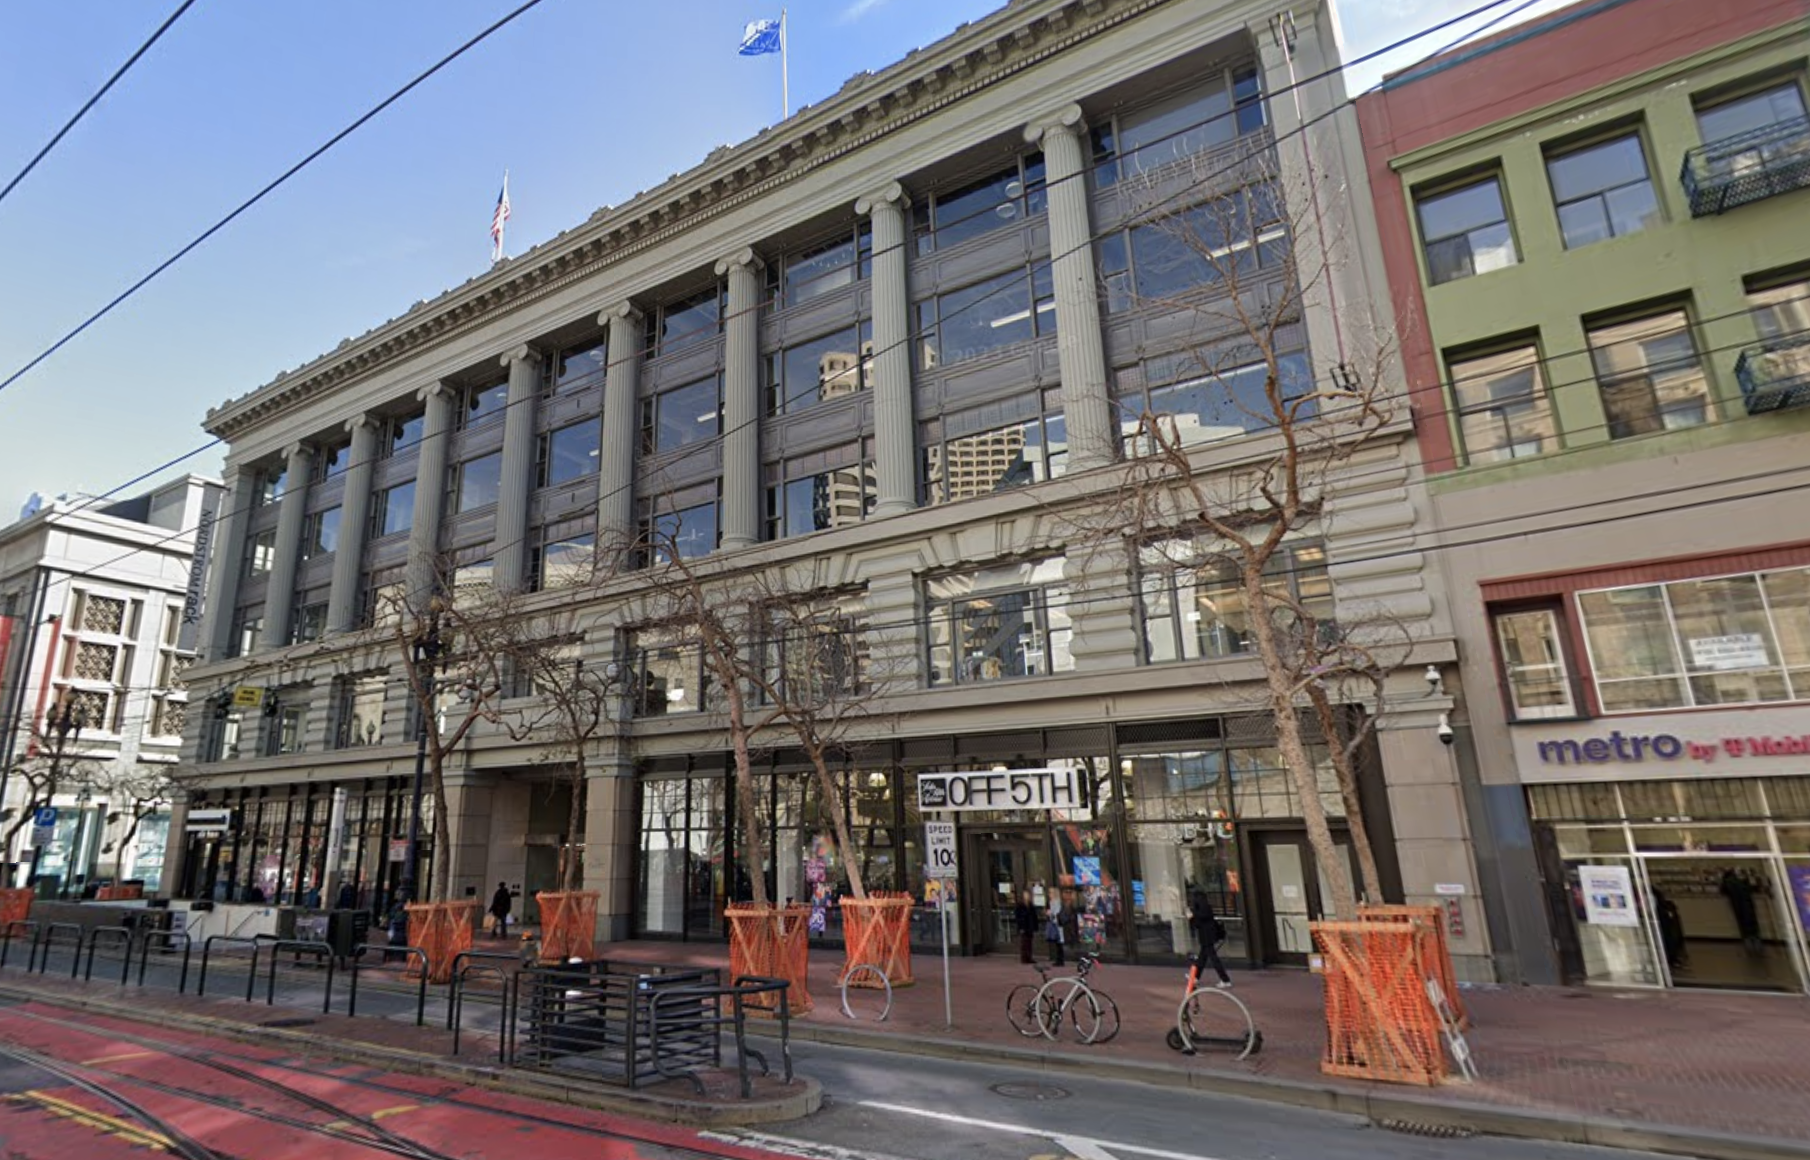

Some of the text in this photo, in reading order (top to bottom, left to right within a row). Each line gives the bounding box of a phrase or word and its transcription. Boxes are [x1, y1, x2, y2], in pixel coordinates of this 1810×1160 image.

[182, 508, 213, 625] NORDSTROM rack
[1537, 730, 1683, 765] metro
[1686, 740, 1718, 764] by
[949, 772, 1073, 806] OFF 5TH
[928, 825, 953, 834] SPEED
[931, 836, 951, 846] LIMIT
